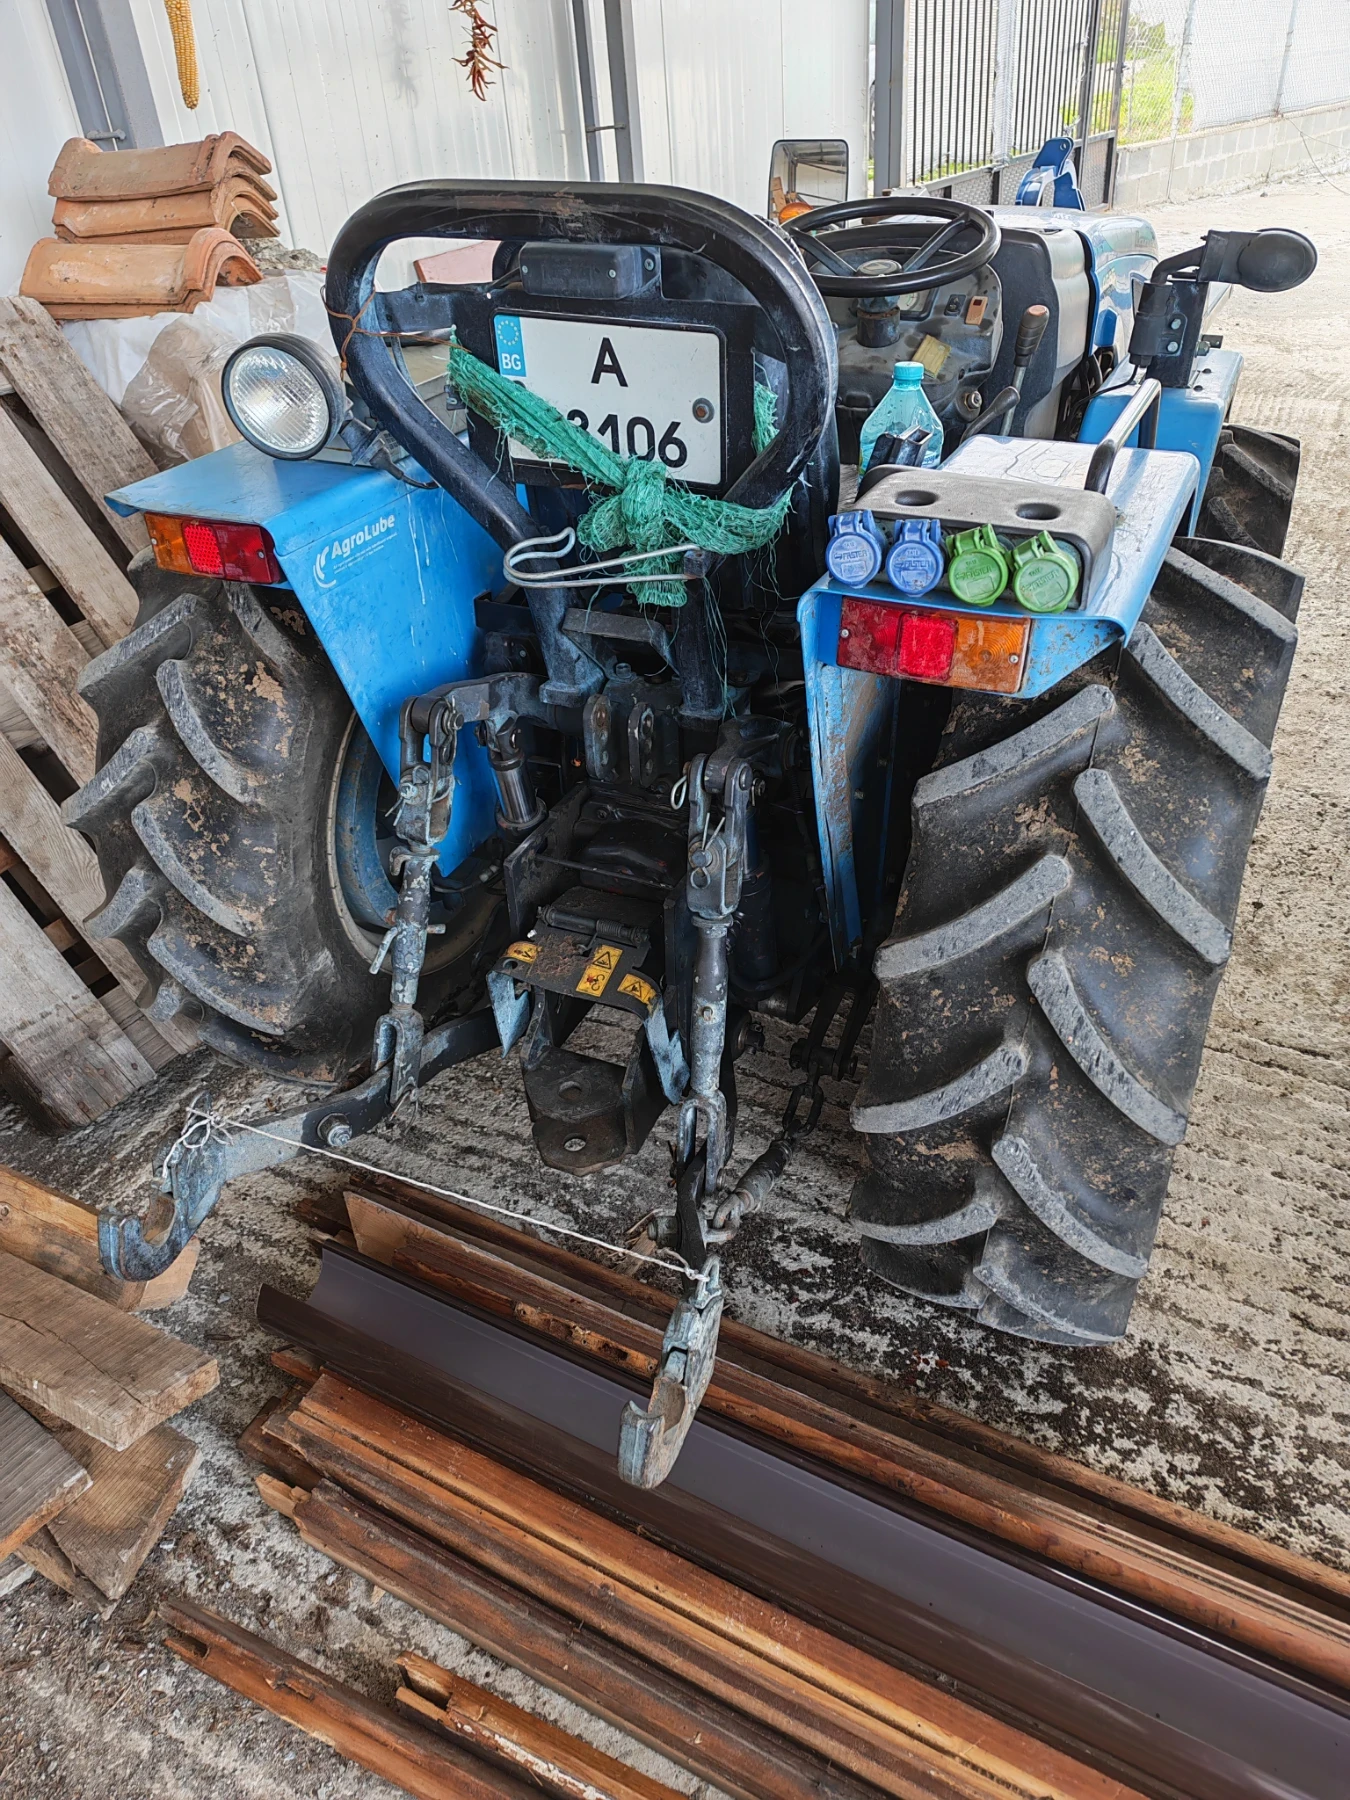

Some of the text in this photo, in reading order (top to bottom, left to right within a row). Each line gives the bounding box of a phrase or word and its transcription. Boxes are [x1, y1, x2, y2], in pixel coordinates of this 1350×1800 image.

[502, 353, 521, 370] BG
[591, 337, 628, 387] A
[331, 515, 396, 559] AgroLube
[843, 550, 867, 560] FASTER
